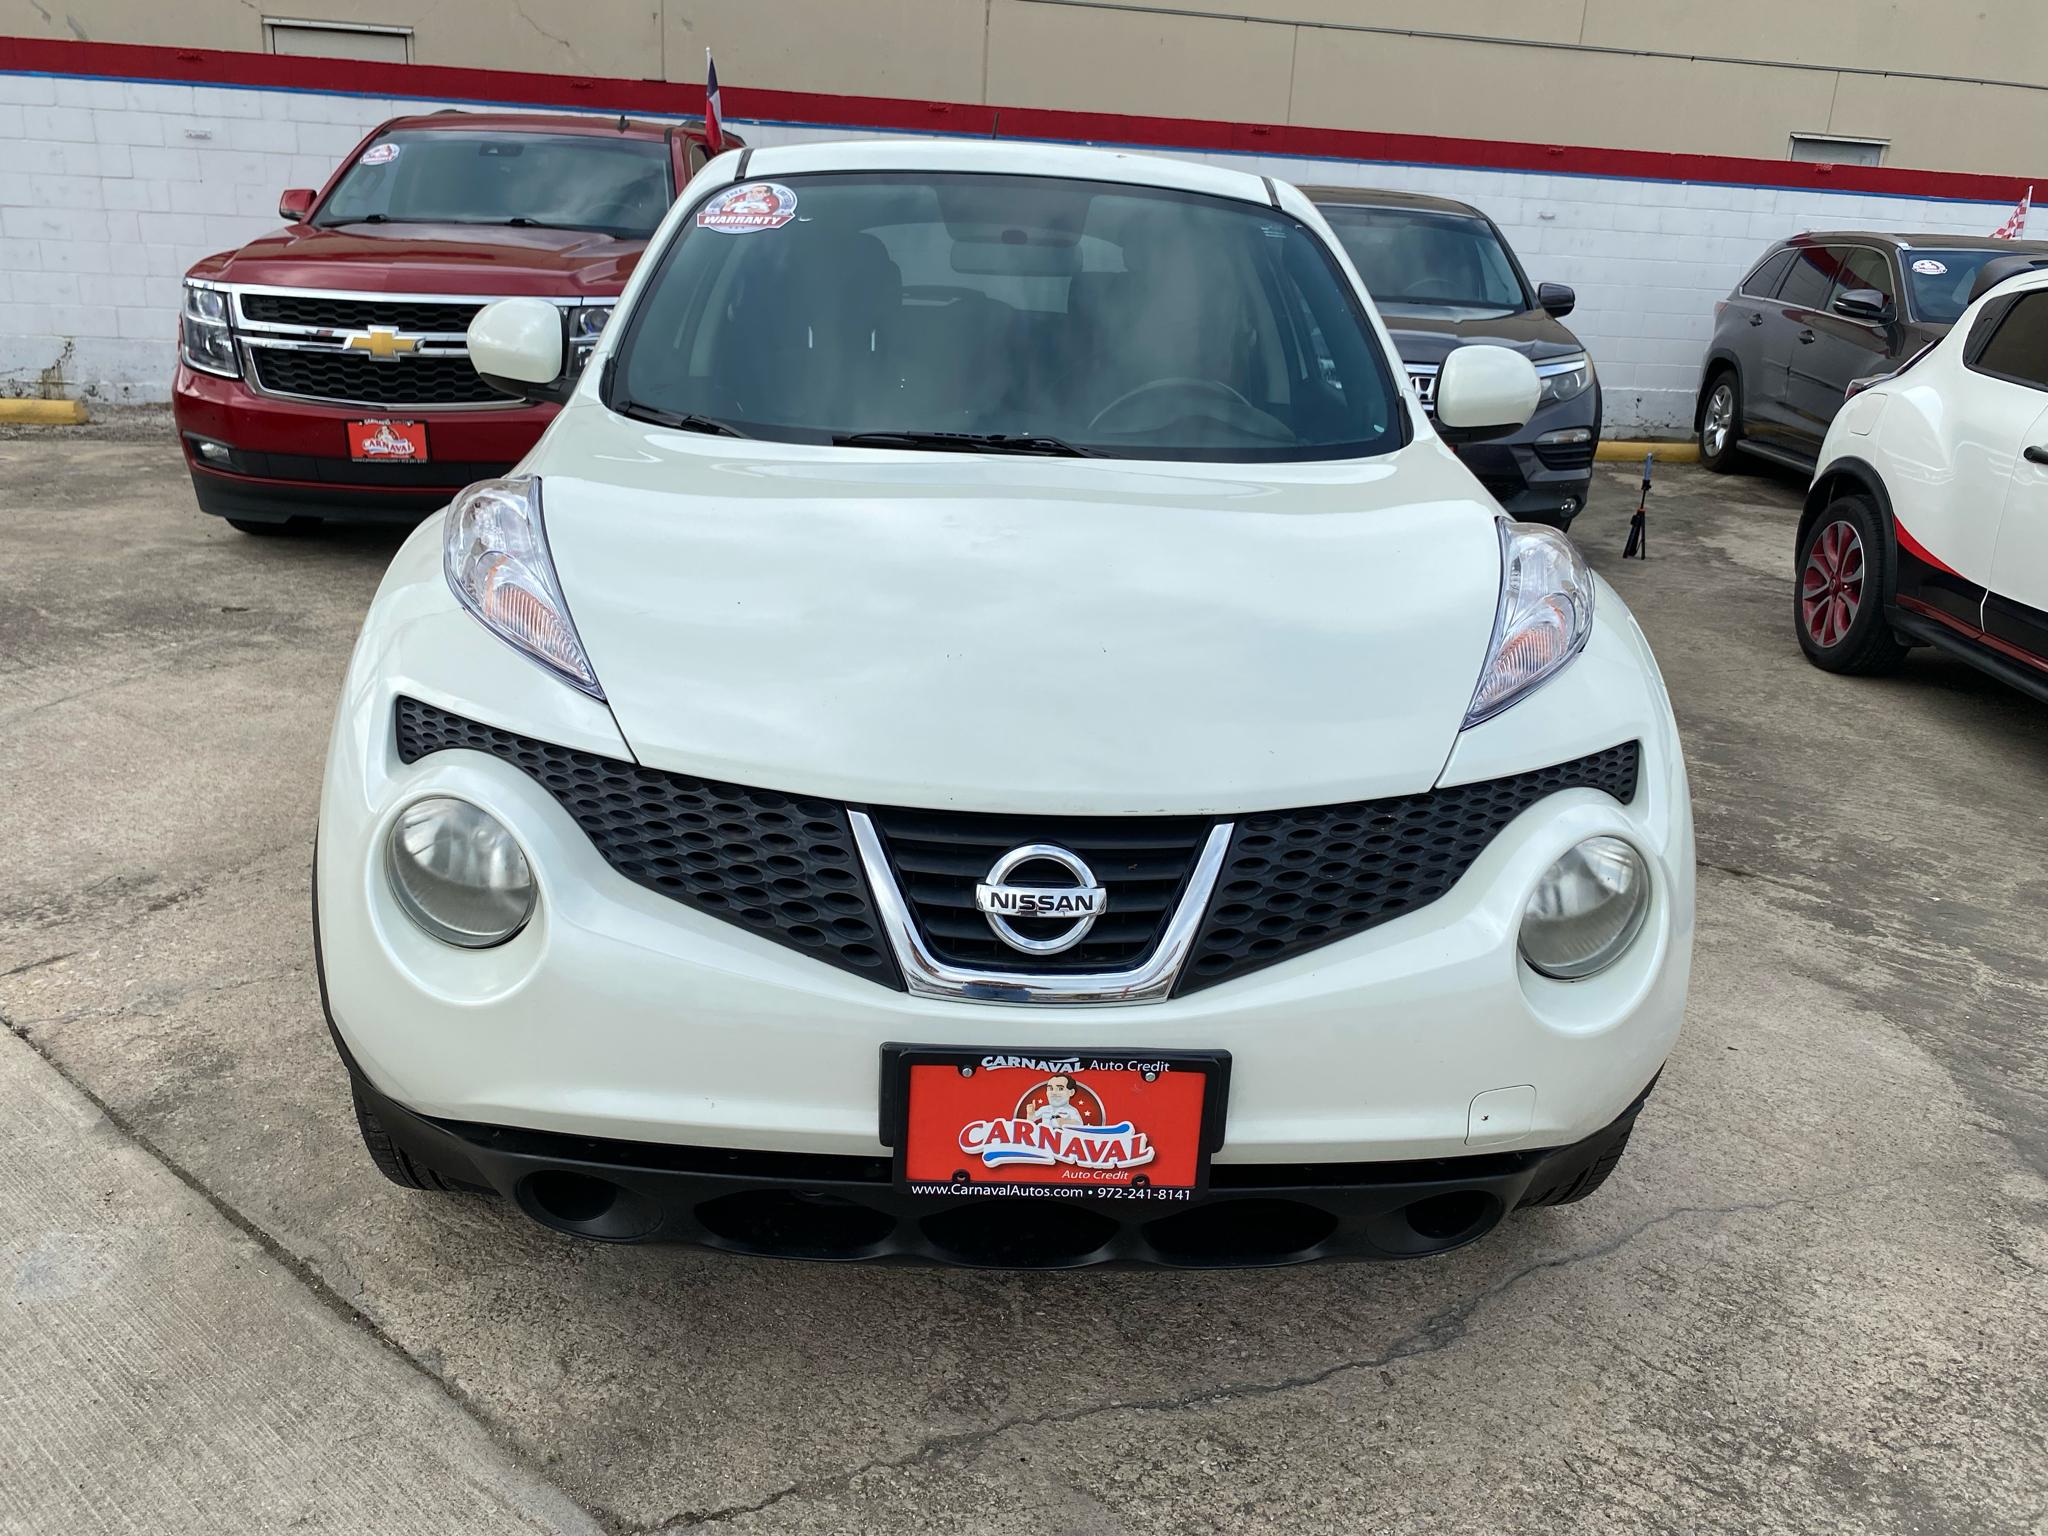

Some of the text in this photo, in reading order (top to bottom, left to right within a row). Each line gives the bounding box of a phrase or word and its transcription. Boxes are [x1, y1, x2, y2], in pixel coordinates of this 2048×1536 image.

[703, 215, 782, 225] WARRANTY
[990, 891, 1094, 912] NISSAN
[981, 1055, 1170, 1073] CARNAVAL Auto Credit
[959, 1120, 1153, 1165] CARNAVAL
[1061, 1169, 1129, 1180] Auto Credit
[911, 1183, 1190, 1200] www.CarnavalAutos.com 972-241-8141
